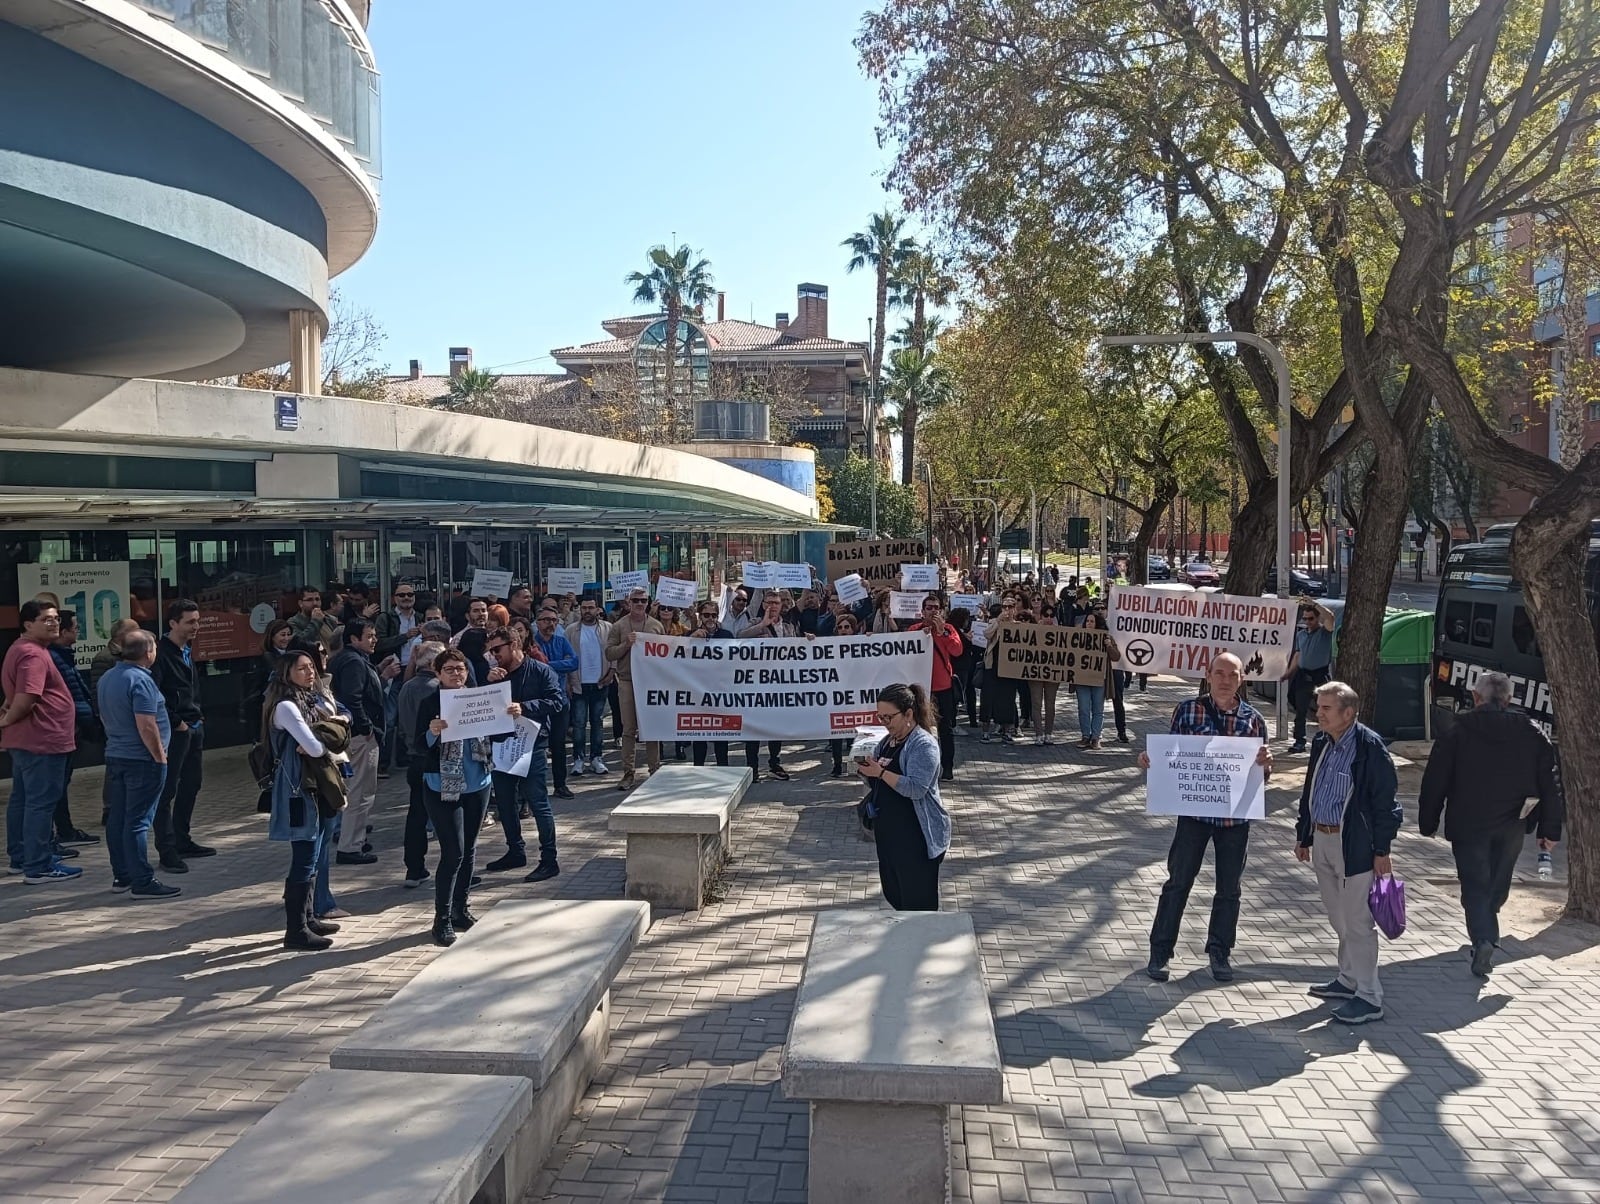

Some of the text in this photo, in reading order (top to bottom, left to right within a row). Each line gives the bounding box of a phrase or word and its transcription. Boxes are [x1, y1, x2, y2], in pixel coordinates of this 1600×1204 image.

[828, 542, 925, 561] BOLSA DE EMPLEO
[59, 570, 110, 578] Ayuntamiento
[1115, 593, 1288, 626] JUBILACIÓN ANTICIPADA
[1003, 629, 1037, 646] BAJA
[1045, 631, 1068, 648] SIN
[1116, 615, 1282, 646] CONDUCTORES DEL S.E.I.S.
[644, 639, 925, 660] NO A LAS POLÍTICAS DE PERSONAL
[1008, 648, 1103, 671] CIUDADANO SIN
[734, 667, 839, 684] DE BALLESTA
[1021, 666, 1075, 683] ASISTIR
[1450, 660, 1554, 715] POCIA
[647, 690, 669, 706] EN
[675, 691, 695, 706] EL
[701, 691, 828, 708] AYUNTAMIENTO
[833, 690, 855, 706] DE
[458, 715, 496, 726] SALARIALES
[461, 707, 494, 717] RECORTES
[833, 714, 873, 726] CCOO
[681, 716, 722, 727] CCOO
[1168, 760, 1241, 772] MÁS DE 20 AÑOS
[1178, 772, 1231, 782] DE FUNESTA
[1178, 783, 1231, 793] POLÍTICA DE
[1181, 794, 1229, 803] PERSONAL
